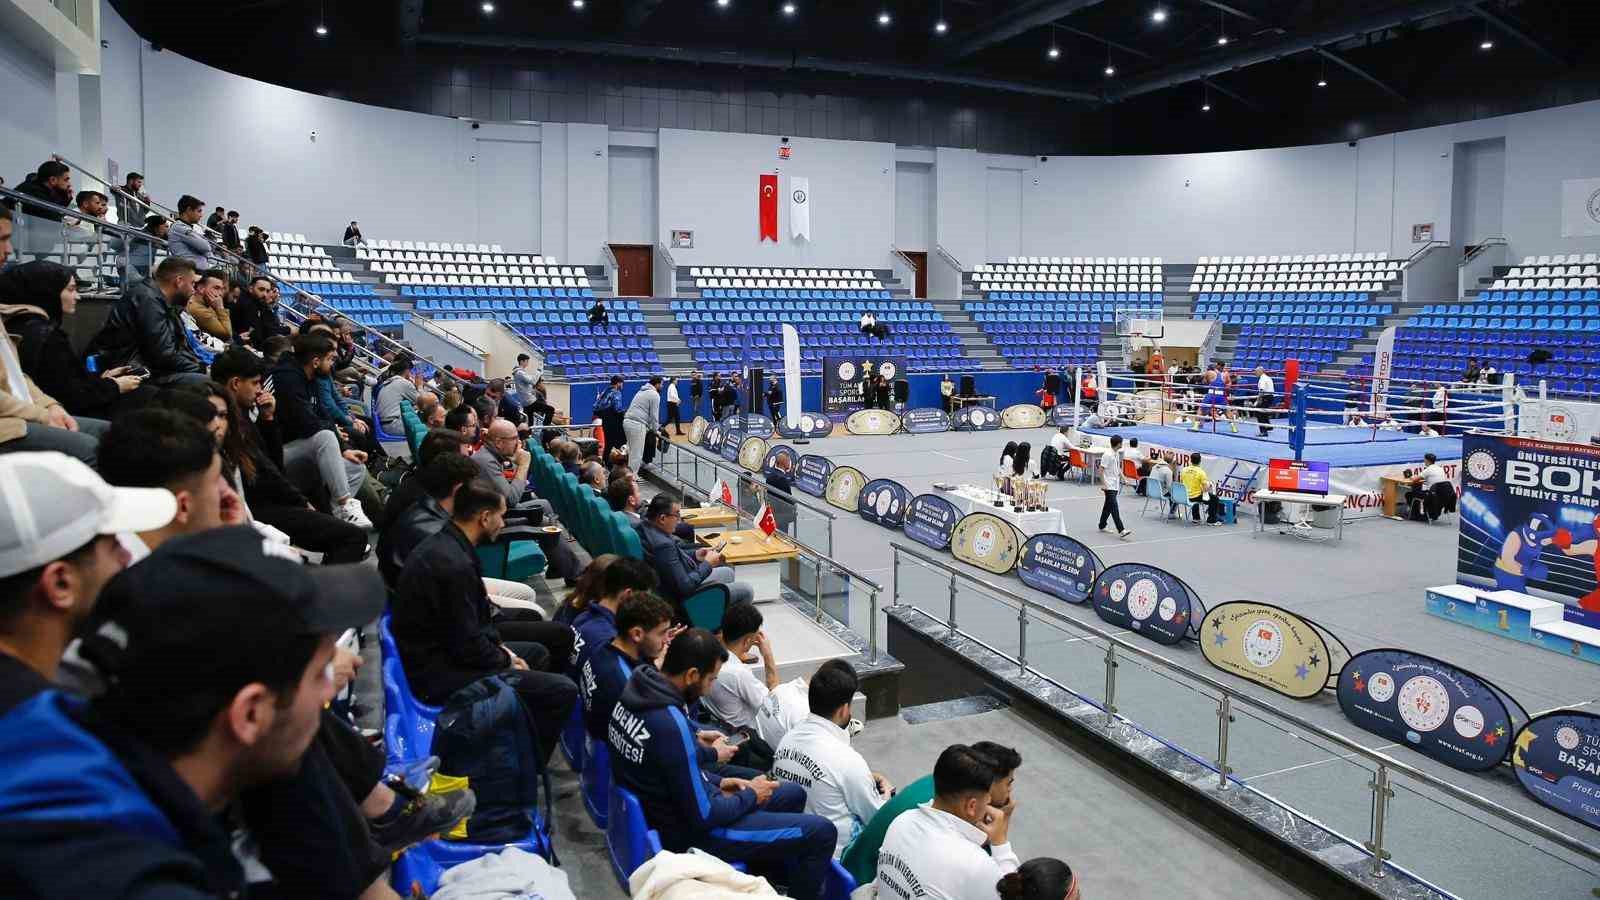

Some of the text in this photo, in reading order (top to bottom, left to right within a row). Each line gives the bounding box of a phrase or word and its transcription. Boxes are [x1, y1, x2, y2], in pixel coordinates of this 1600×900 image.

[828, 396, 865, 405] BAŞARILA
[1509, 486, 1558, 502] TÜRKİYE
[1562, 494, 1600, 508] ŞAMP
[1497, 608, 1512, 631] 1
[775, 766, 813, 788] ERZURUM
